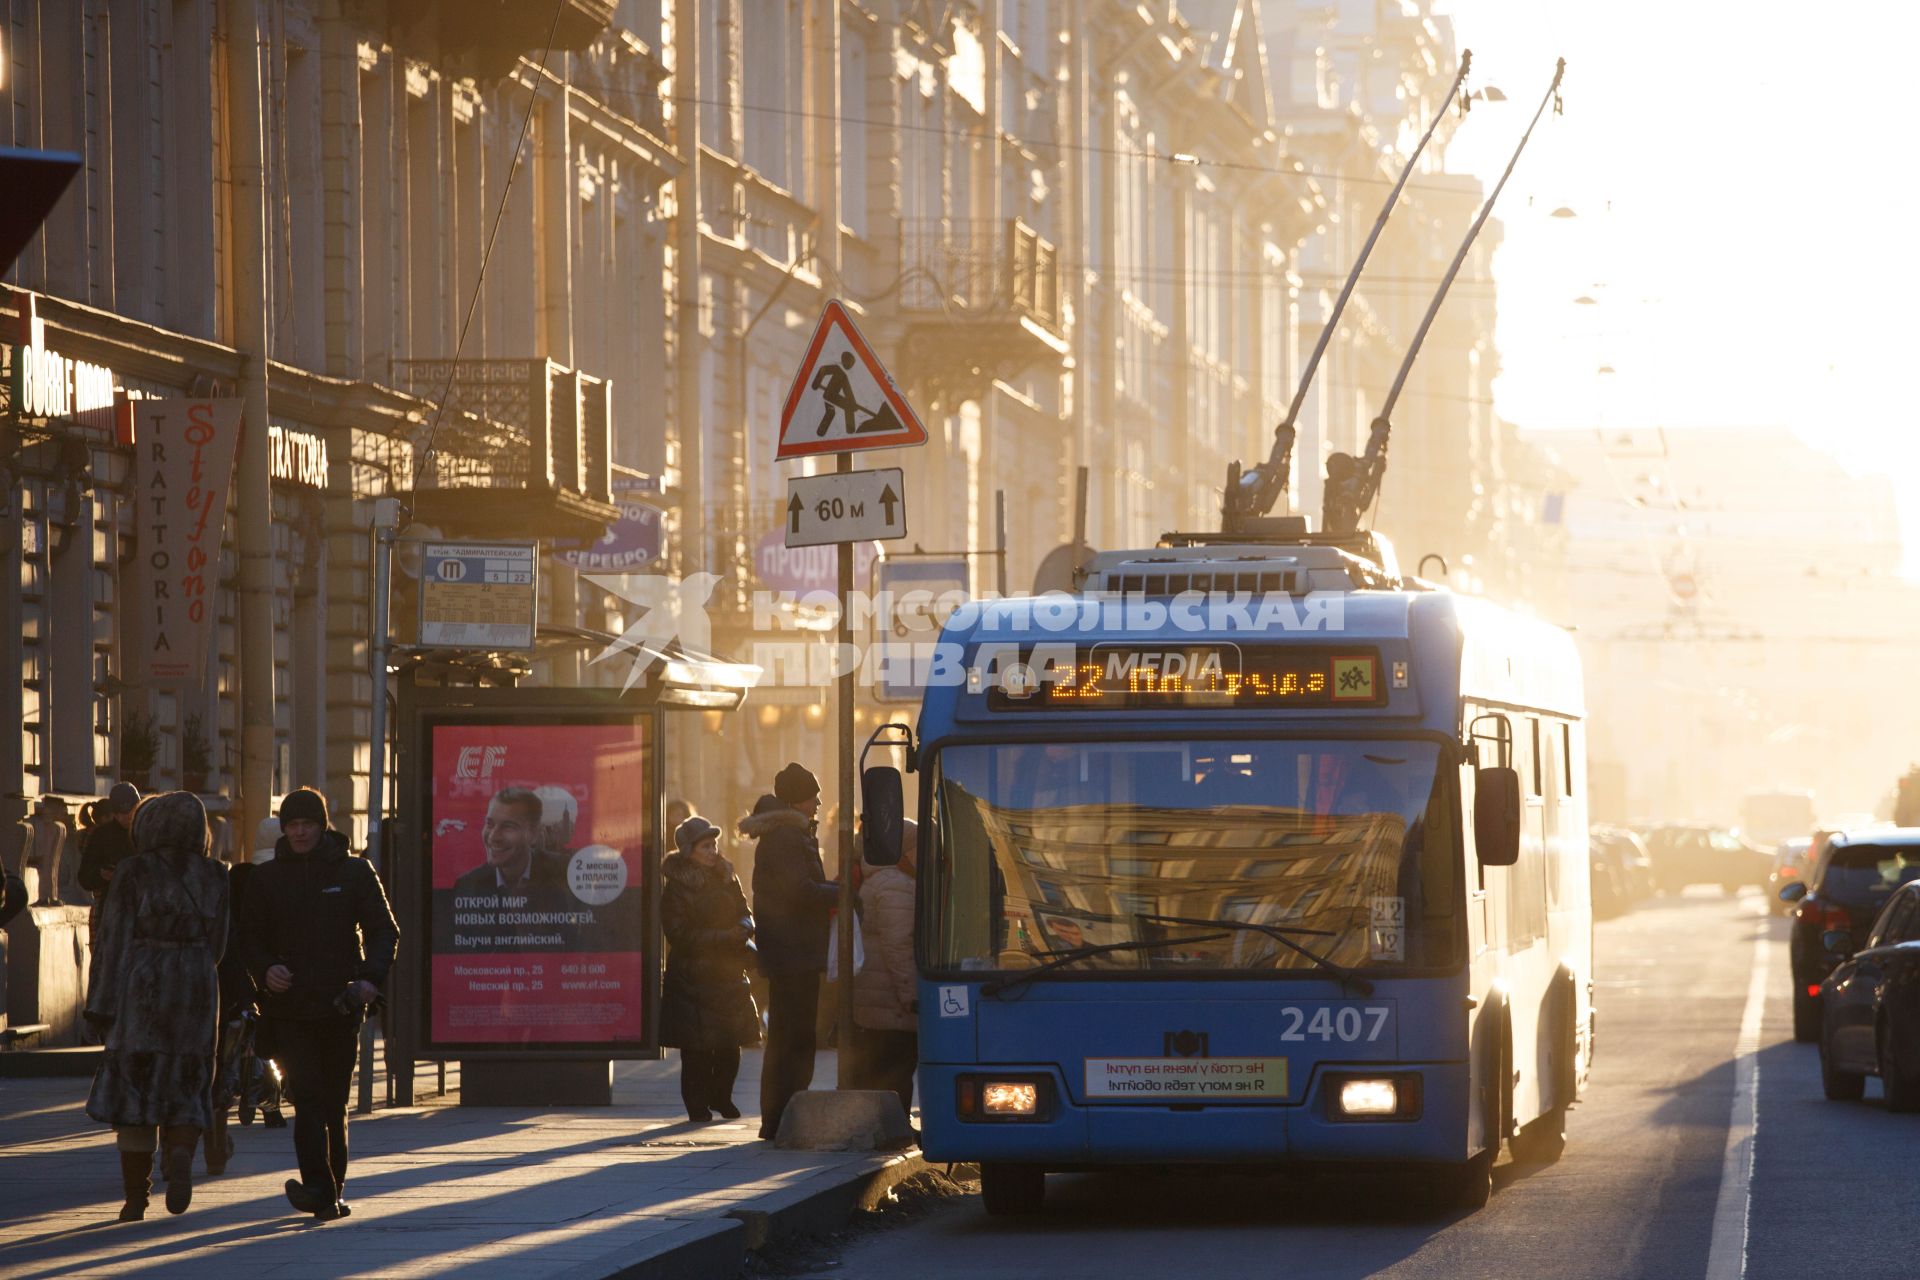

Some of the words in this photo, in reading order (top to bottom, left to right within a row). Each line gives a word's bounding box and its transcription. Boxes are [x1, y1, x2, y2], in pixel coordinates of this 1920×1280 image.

[268, 426, 328, 489] TRATTORIA
[818, 497, 844, 521] 60
[150, 415, 170, 651] TRATTORIA
[566, 547, 648, 568] СЕРЕБРО
[1052, 665, 1103, 697] 22
[456, 746, 507, 778] EF
[576, 859, 583, 870] 2
[455, 895, 499, 909] ОТКРОЙ
[502, 896, 528, 909] МИР
[455, 913, 496, 925] НОВЫХ
[454, 934, 492, 948] Выучи
[1280, 1006, 1389, 1041] 2407
